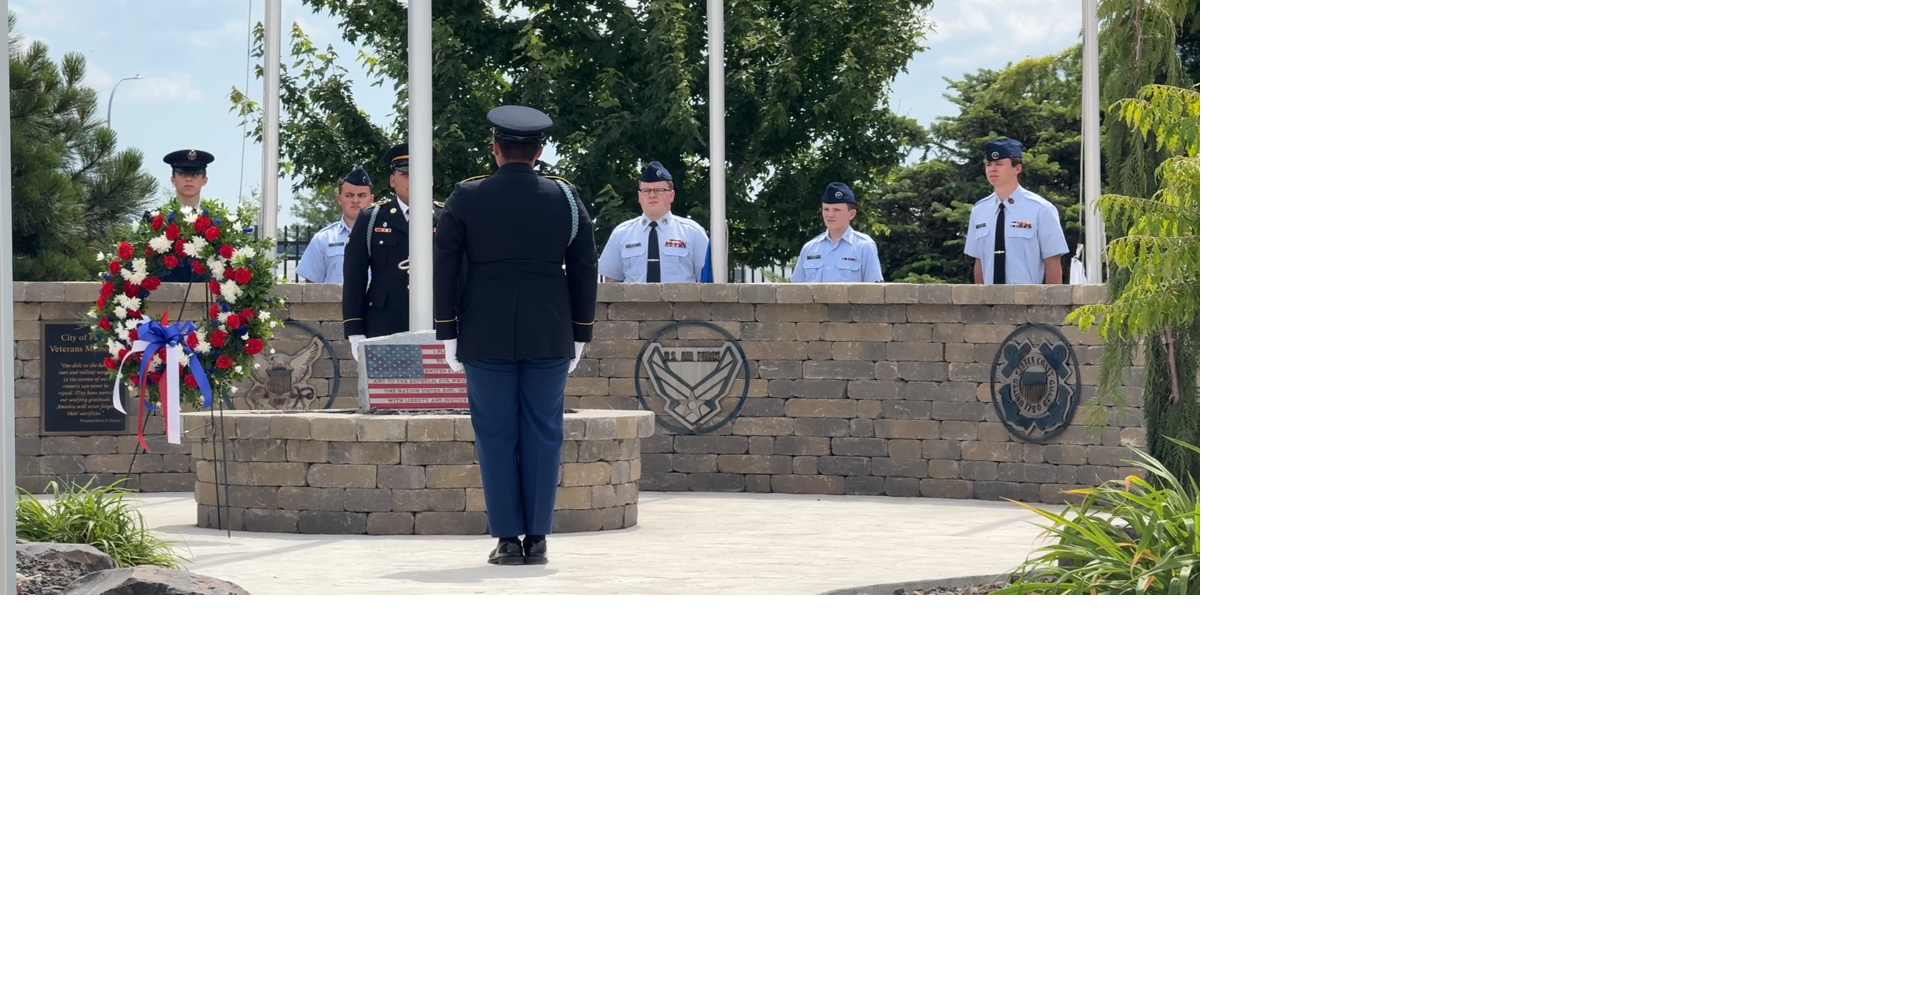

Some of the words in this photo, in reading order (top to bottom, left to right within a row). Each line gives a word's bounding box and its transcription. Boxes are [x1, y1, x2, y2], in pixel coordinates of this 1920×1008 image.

[60, 334, 76, 342] City
[681, 351, 694, 361] AIR
[1015, 356, 1035, 376] STATES
[1037, 357, 1054, 377] COAST
[1043, 380, 1056, 407] GUARD
[1024, 403, 1042, 413] 1790
